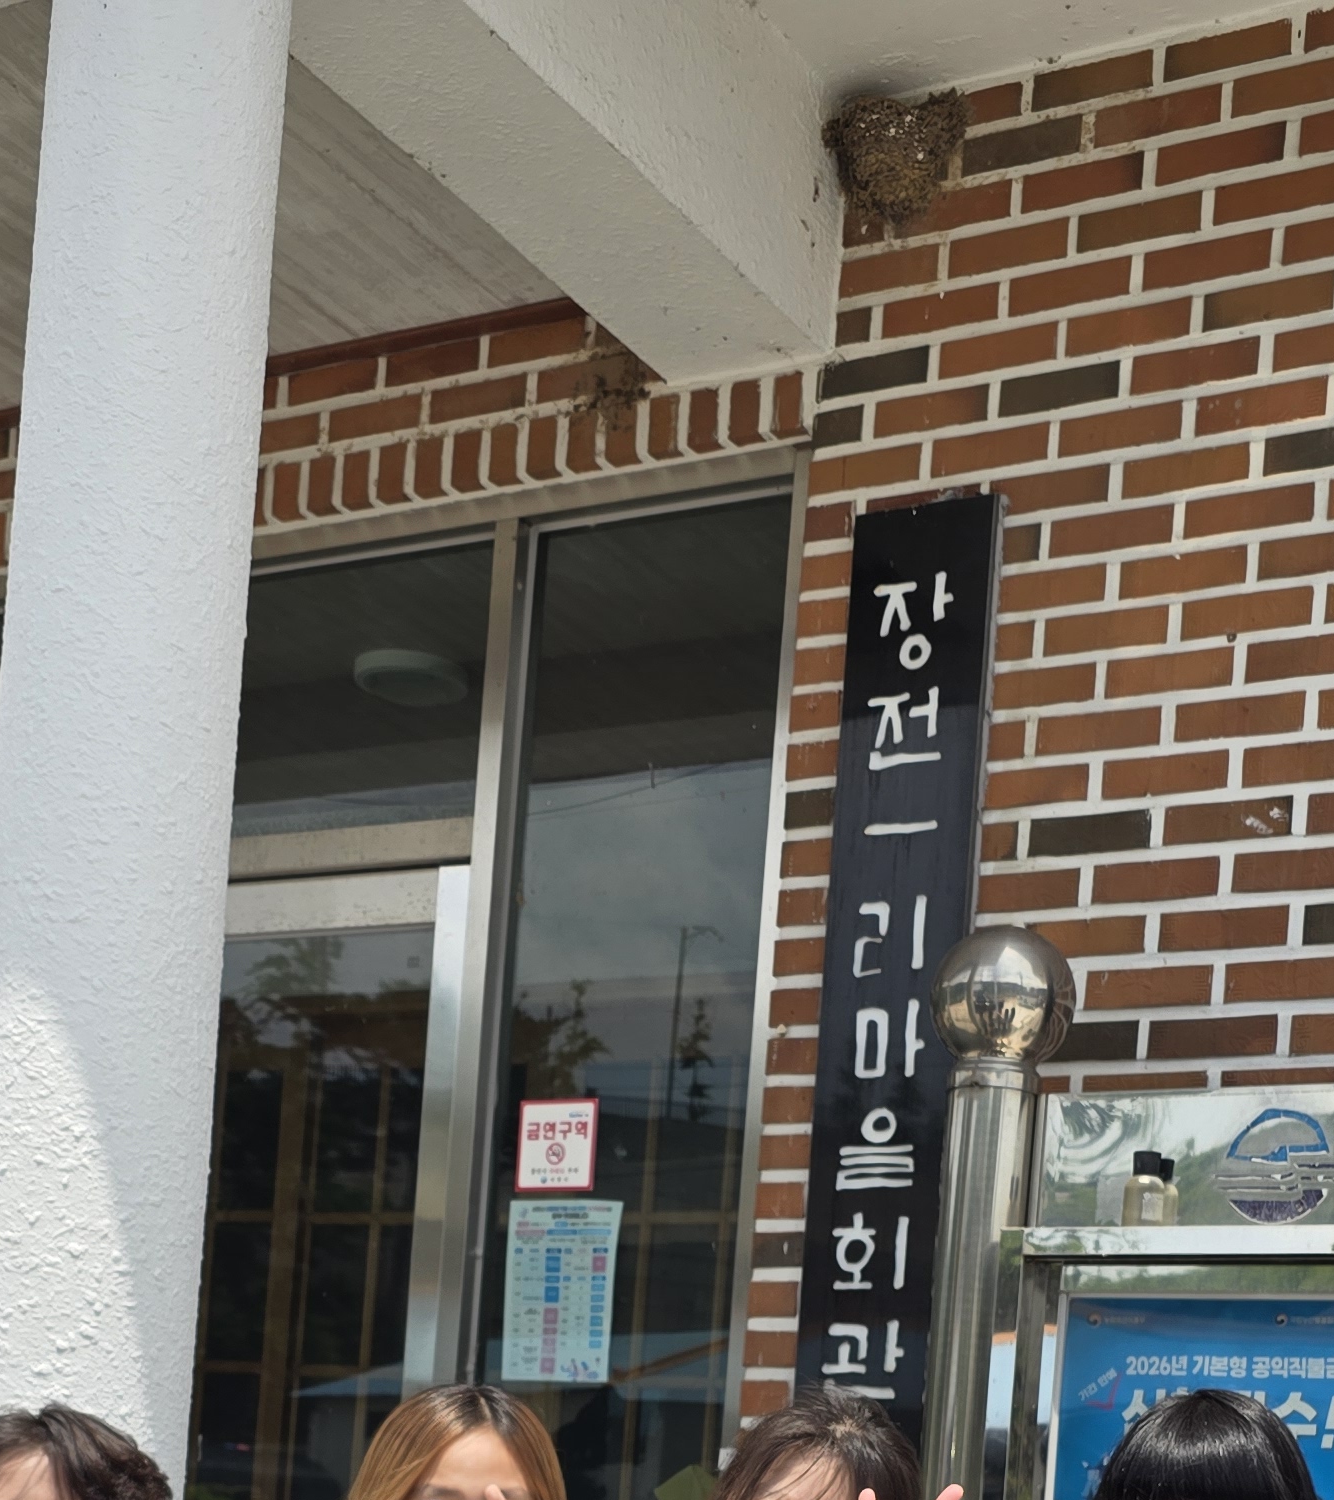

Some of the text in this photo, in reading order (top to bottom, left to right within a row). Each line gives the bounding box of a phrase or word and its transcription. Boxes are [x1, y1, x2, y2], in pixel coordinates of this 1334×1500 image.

[527, 1120, 589, 1141] 금연구역
[1125, 1355, 1187, 1377] 2026년
[1192, 1355, 1247, 1378] 기본형
